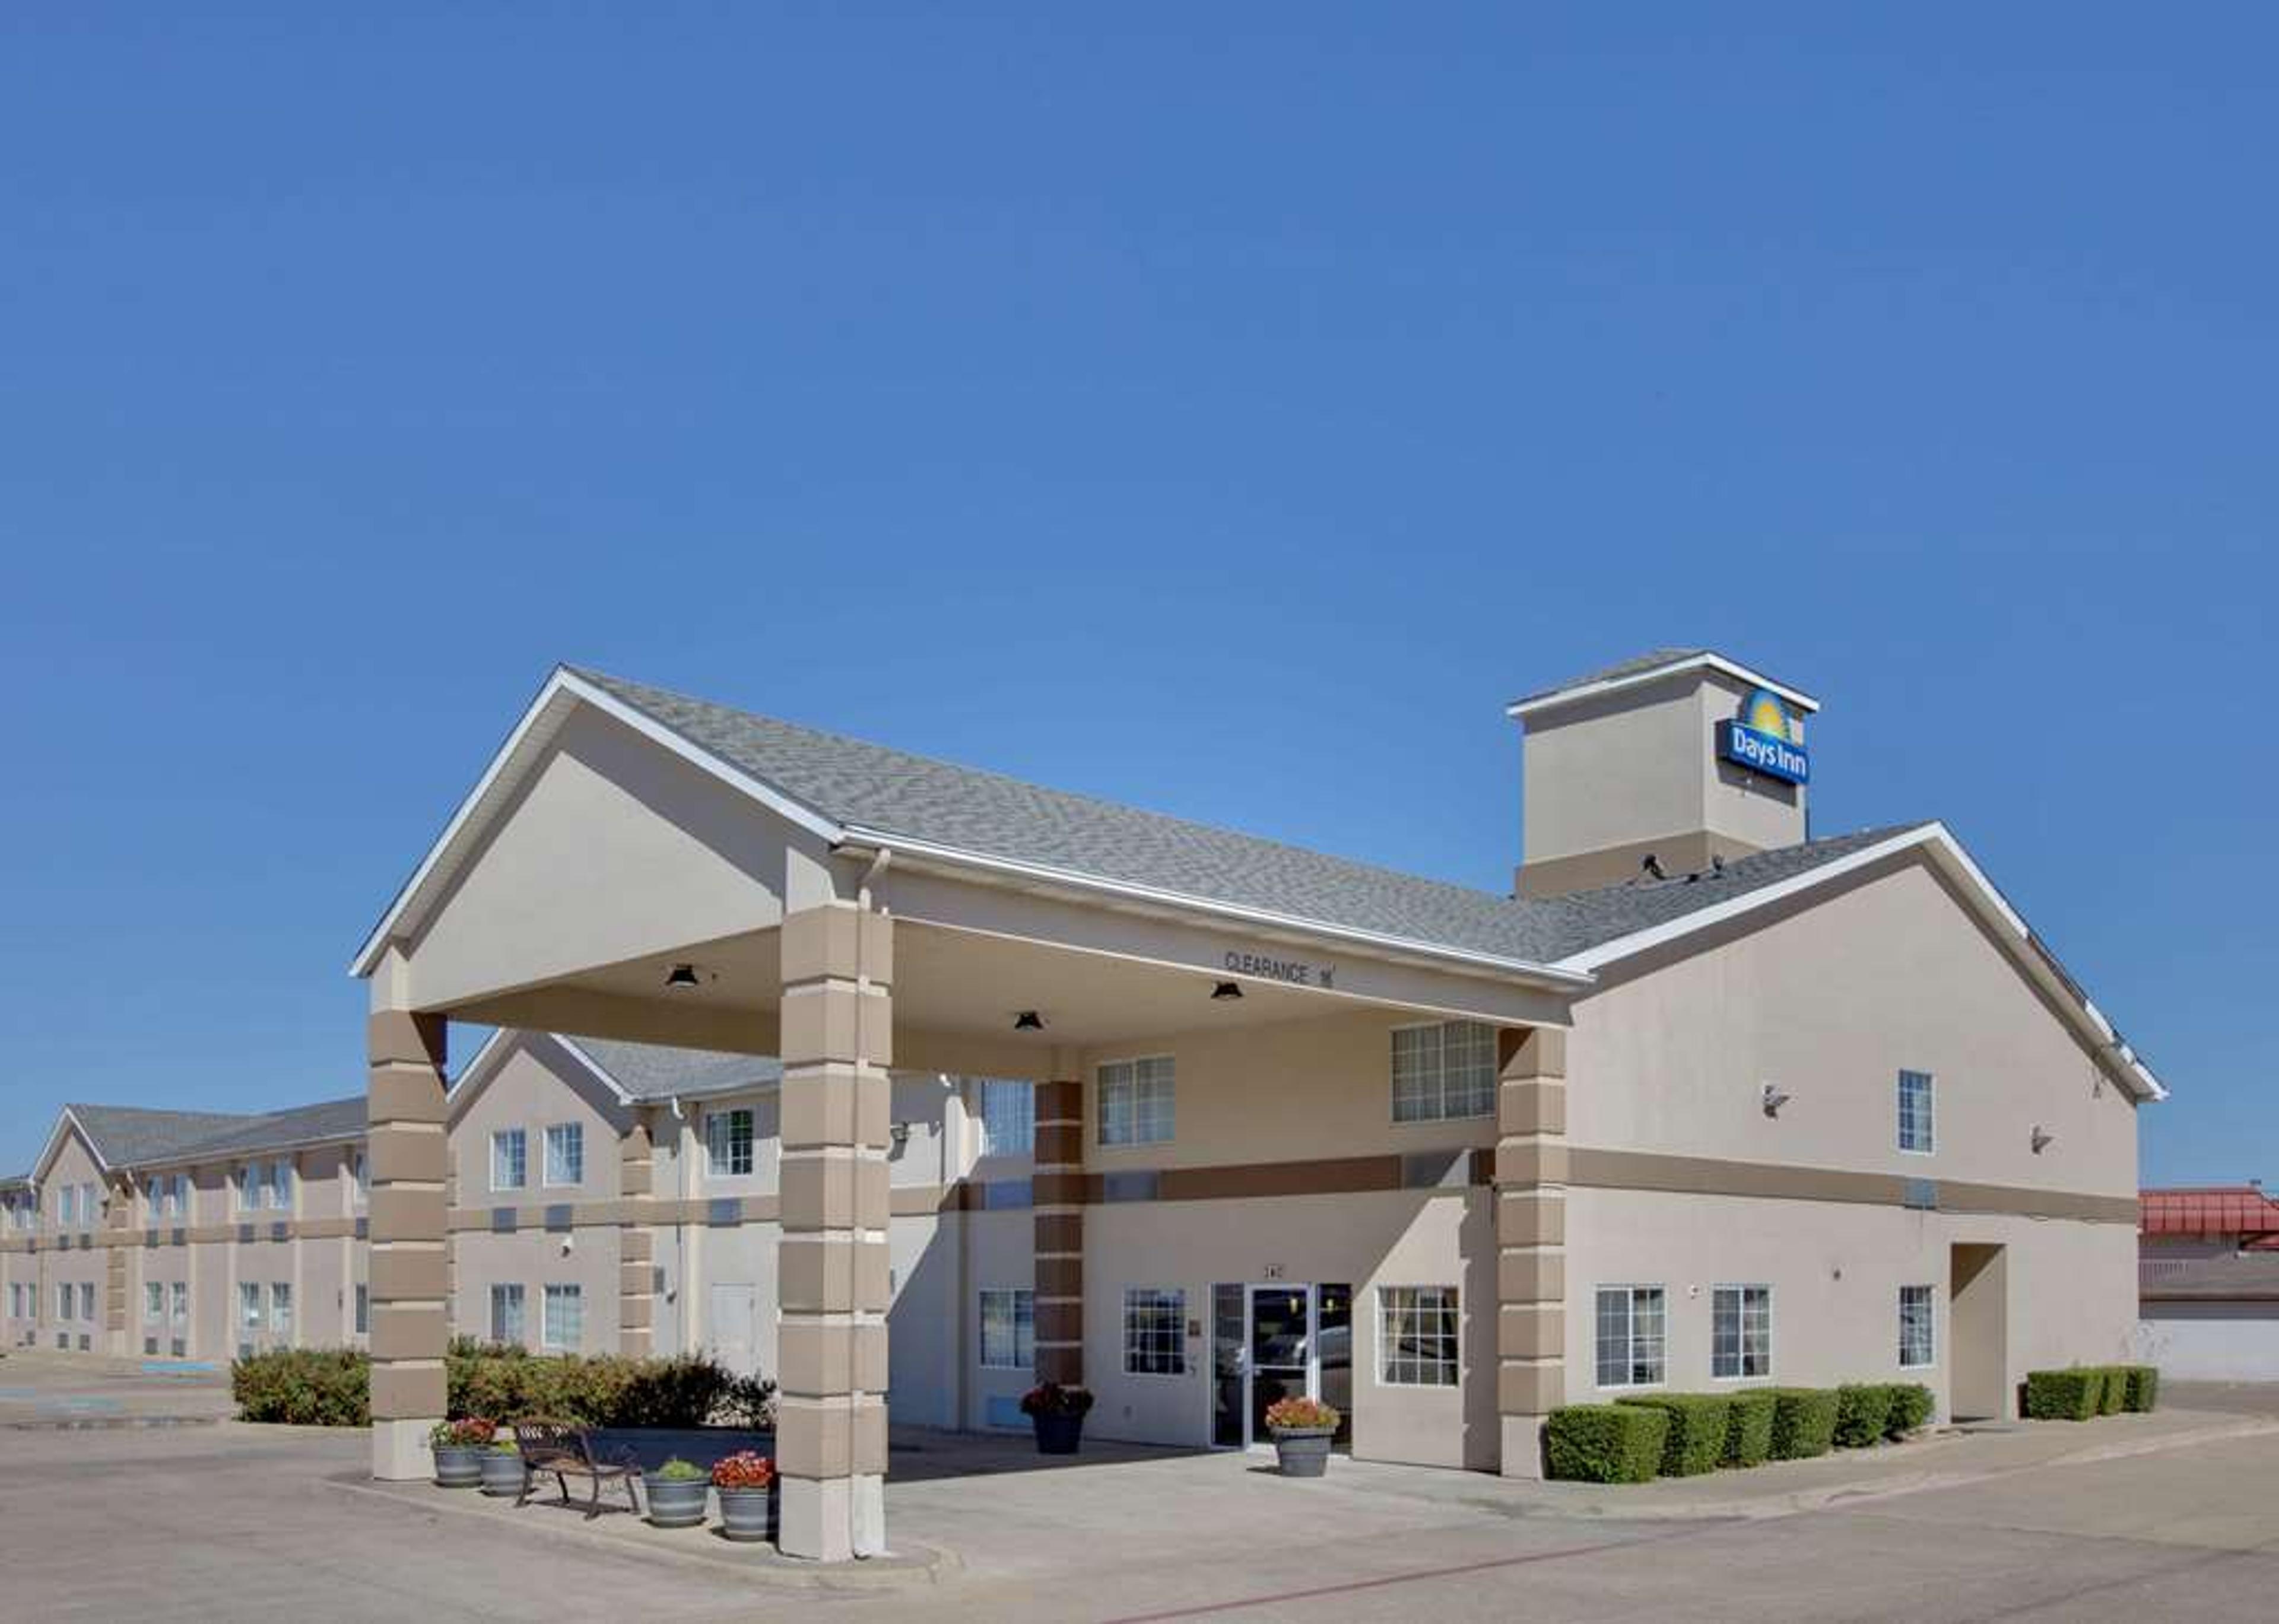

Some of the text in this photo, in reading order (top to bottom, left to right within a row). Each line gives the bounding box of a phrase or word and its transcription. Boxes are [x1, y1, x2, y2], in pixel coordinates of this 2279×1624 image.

[1733, 727, 1806, 777] Days Inn
[1225, 951, 1309, 984] CLEARANCE
